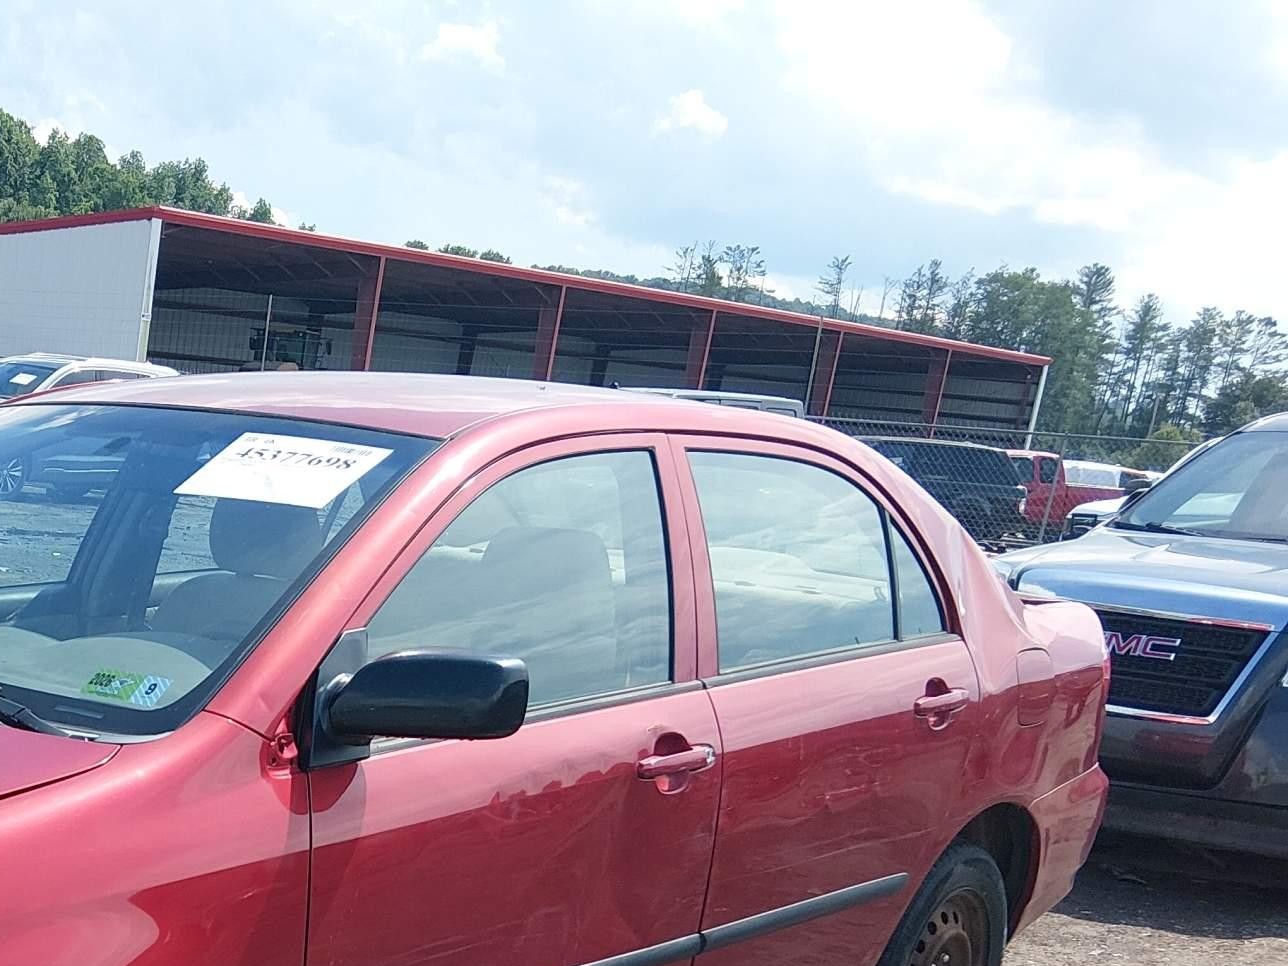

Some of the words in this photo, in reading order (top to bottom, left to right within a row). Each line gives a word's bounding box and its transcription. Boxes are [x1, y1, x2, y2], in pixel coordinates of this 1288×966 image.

[235, 447, 357, 469] 45377698
[1104, 631, 1181, 660] MC
[145, 683, 158, 695] 9
